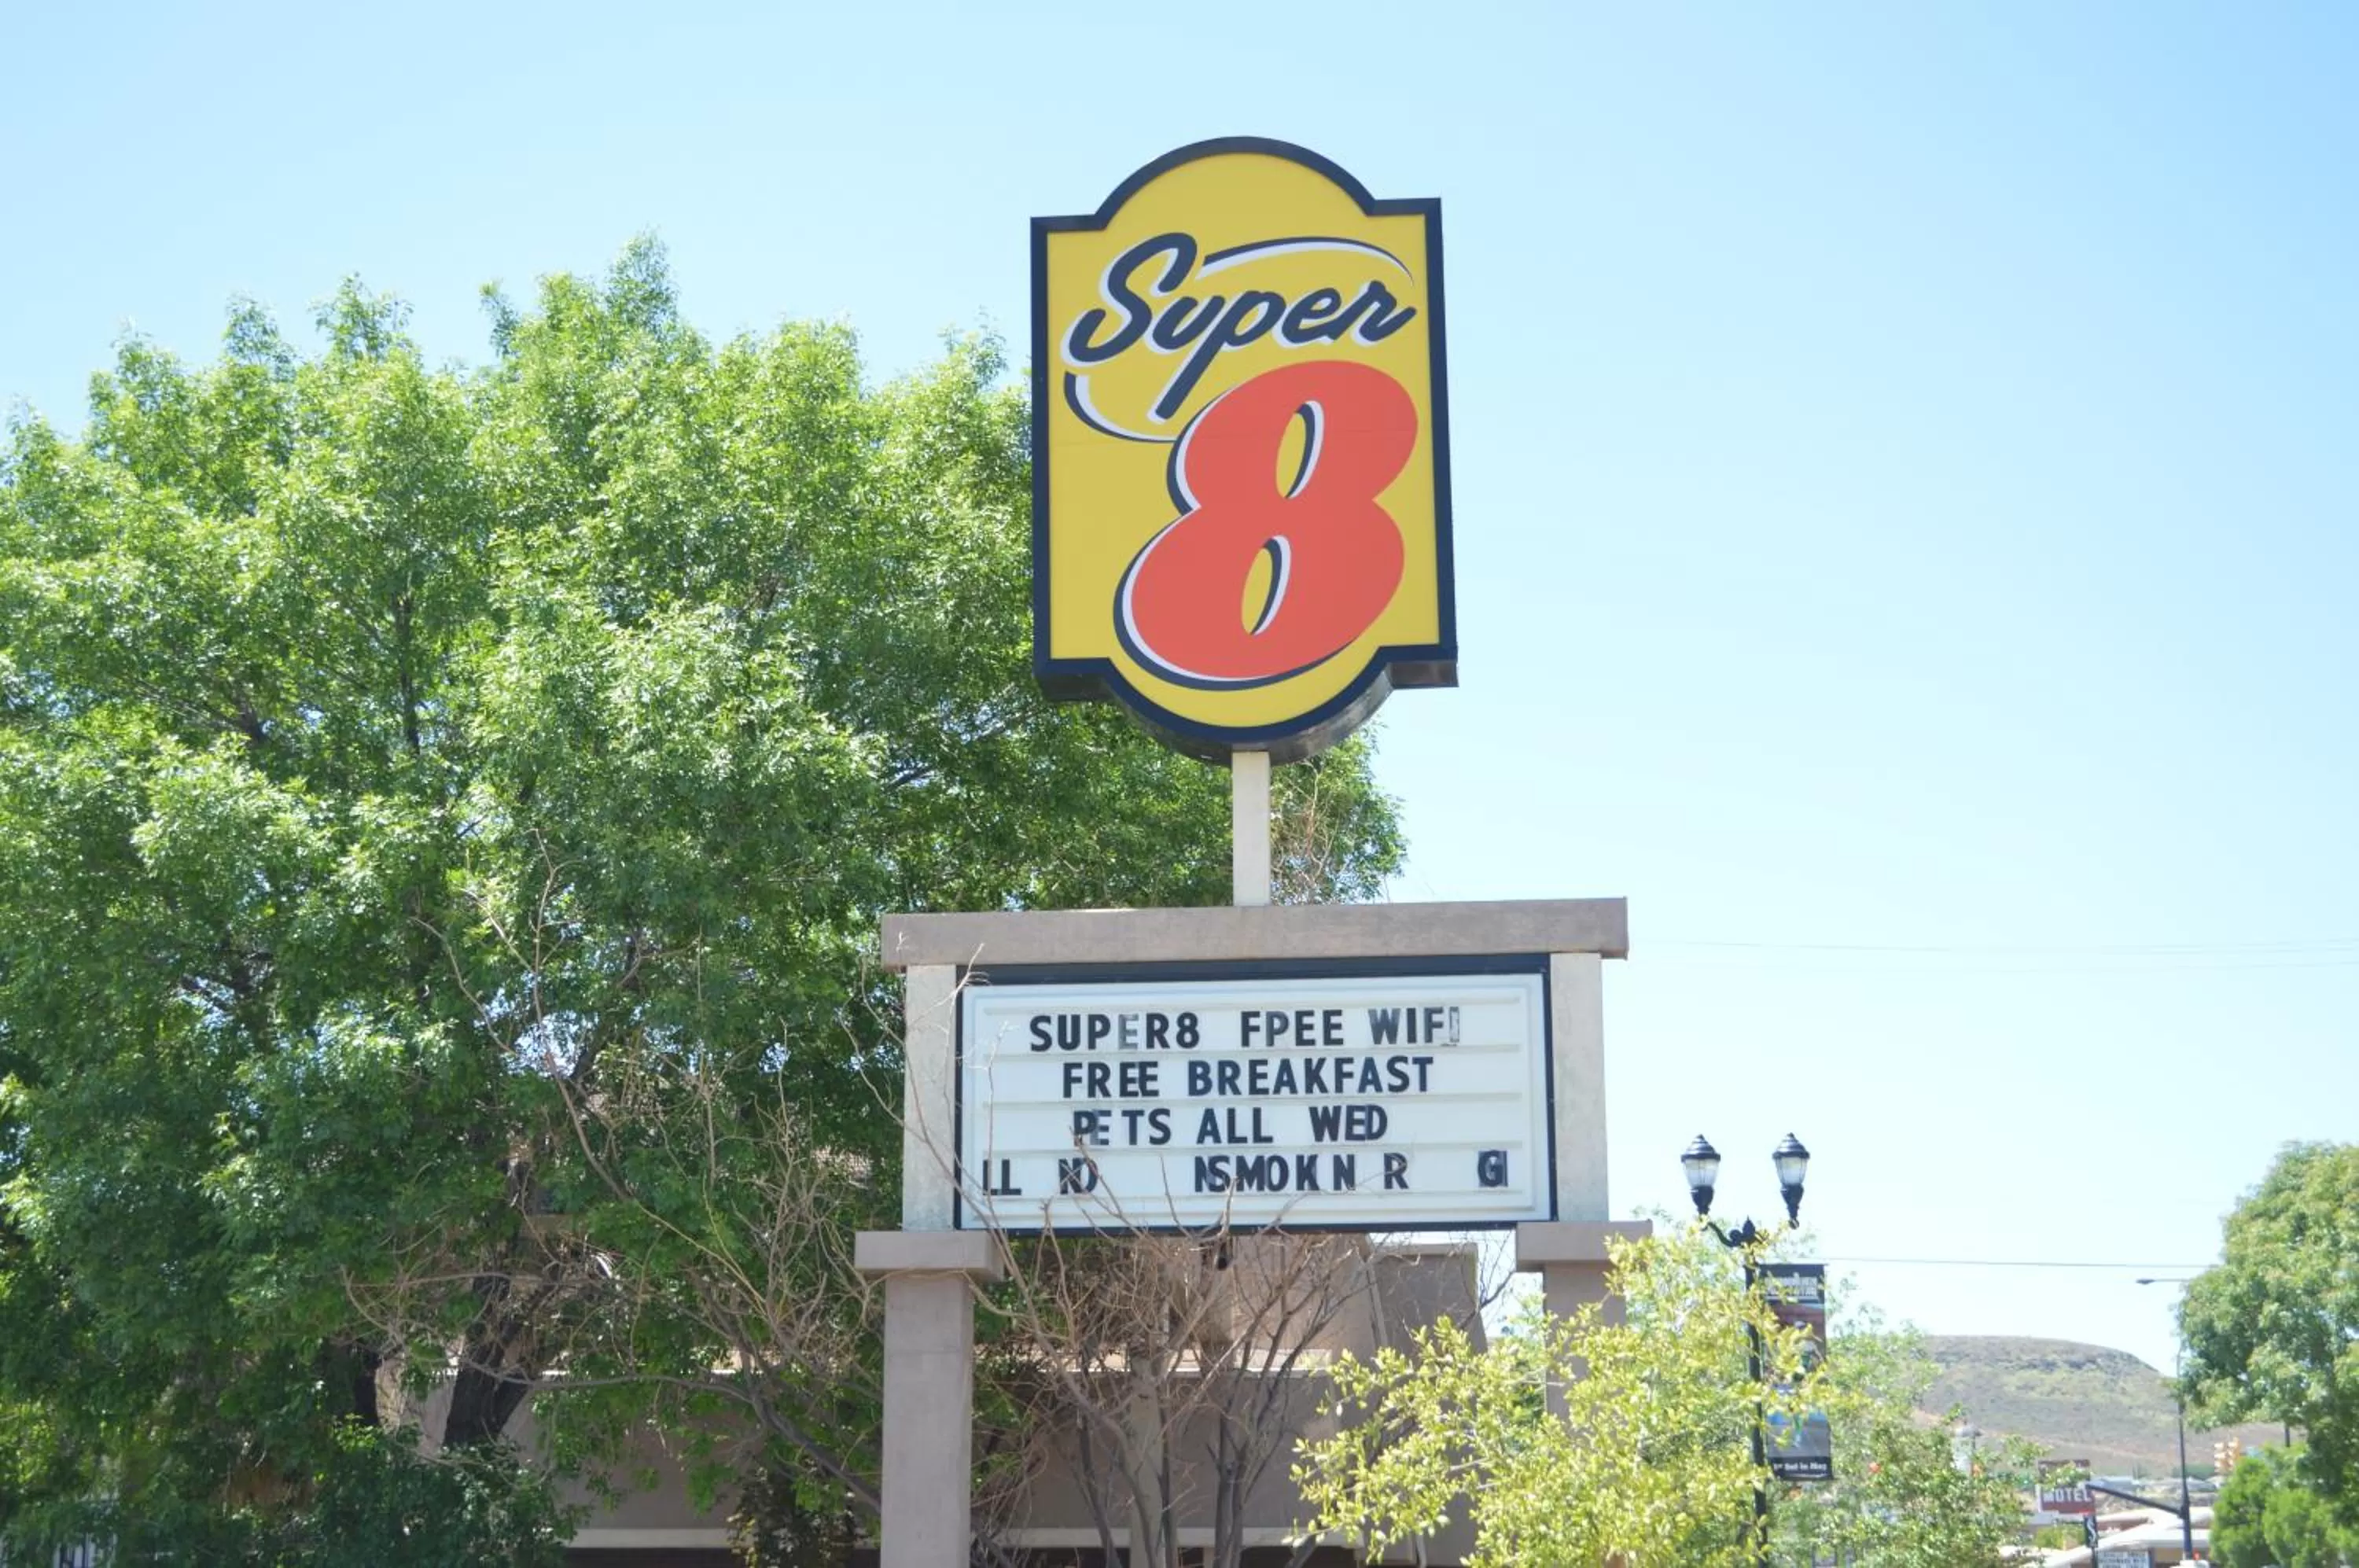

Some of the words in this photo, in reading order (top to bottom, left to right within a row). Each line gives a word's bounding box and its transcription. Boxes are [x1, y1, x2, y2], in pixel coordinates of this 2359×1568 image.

[1061, 230, 1417, 424] Super
[1113, 359, 1419, 692] 8
[1029, 1011, 1201, 1052] SUPER8
[1062, 1061, 1160, 1098] FREE
[1187, 1055, 1434, 1096] BREAKFAST
[1073, 1107, 1172, 1147] PETS
[1197, 1106, 1274, 1145] ALL
[1308, 1104, 1389, 1143] WED
